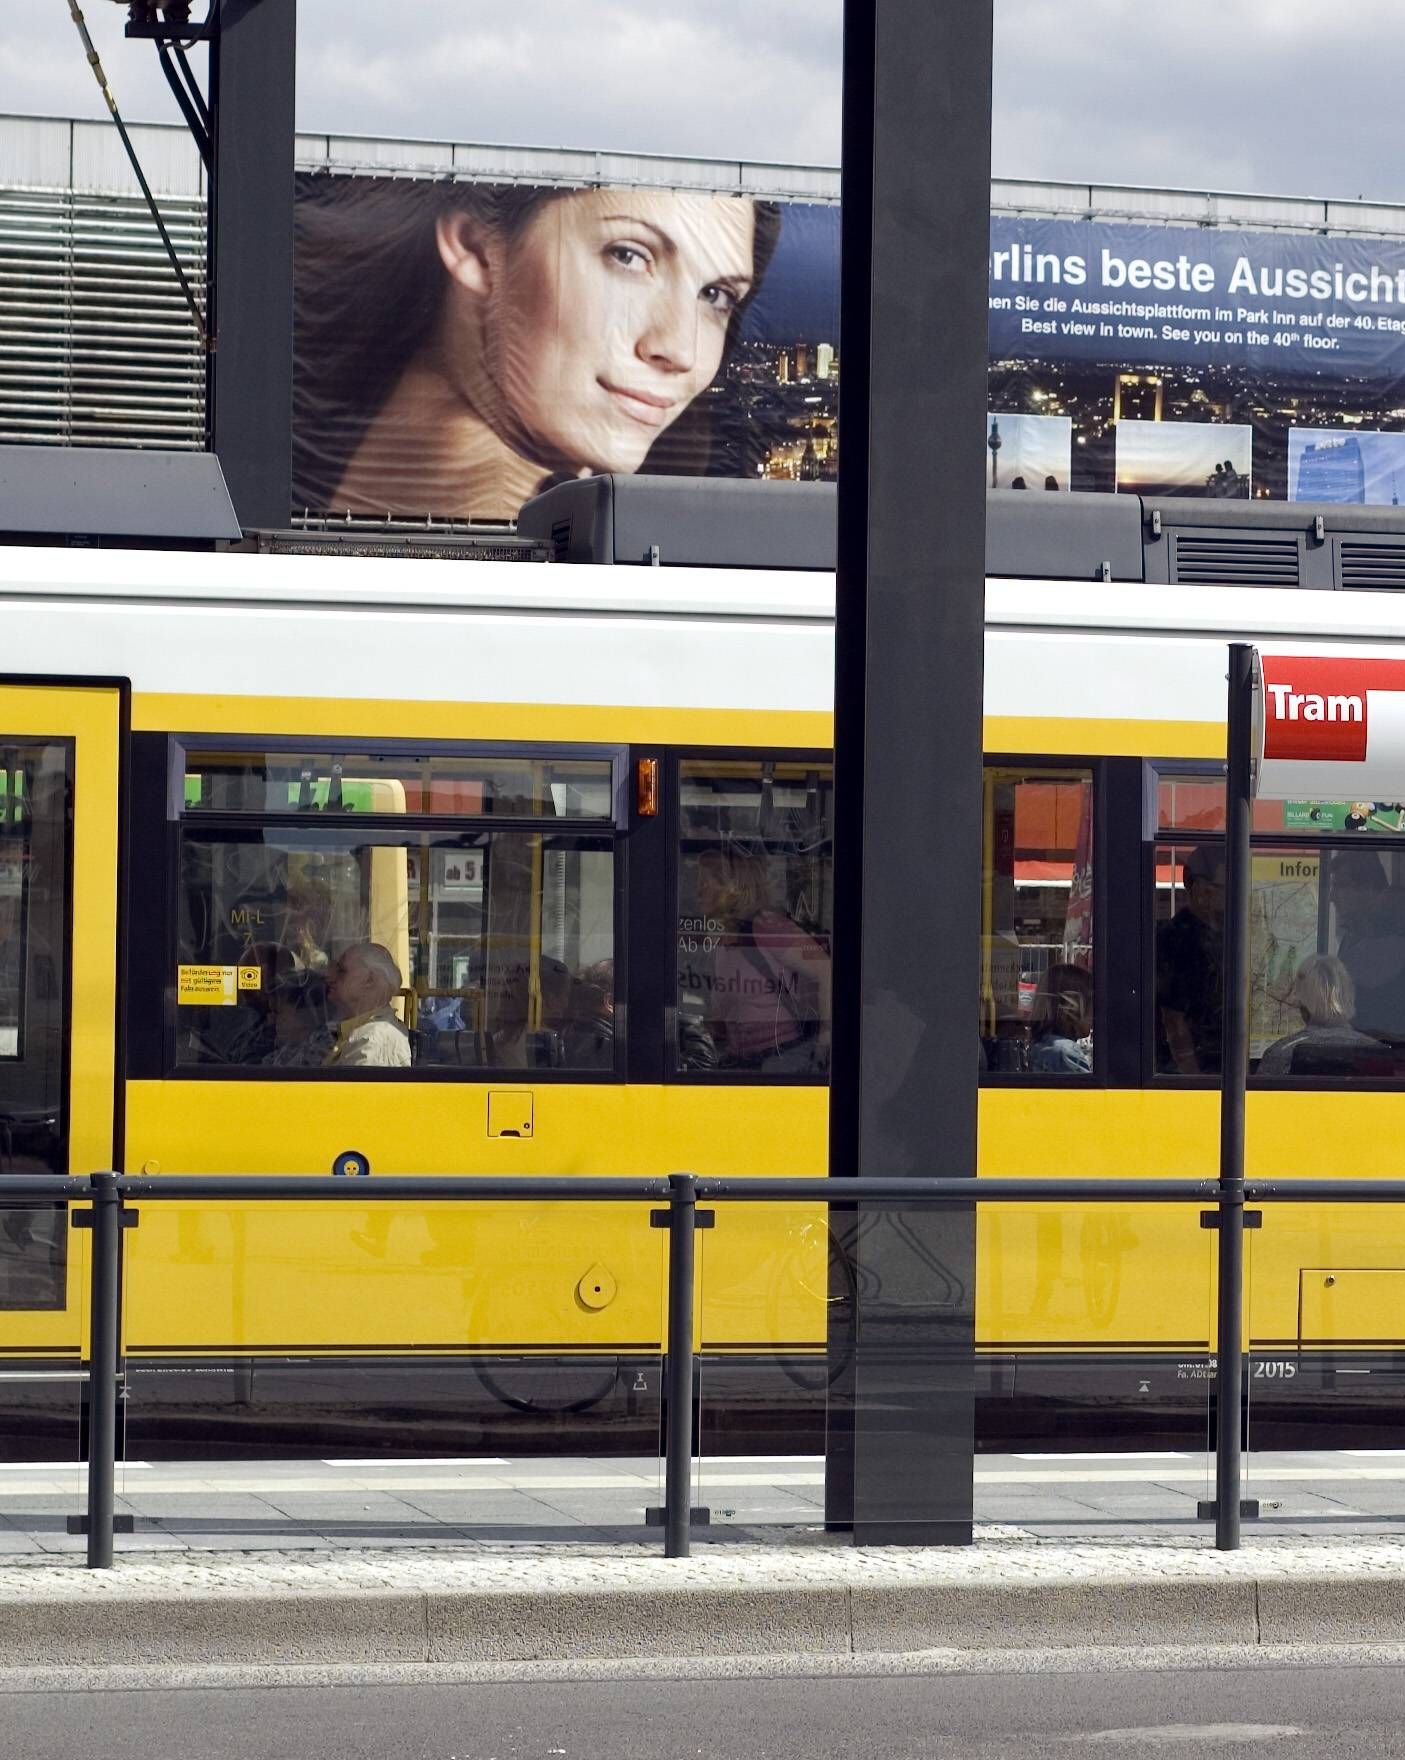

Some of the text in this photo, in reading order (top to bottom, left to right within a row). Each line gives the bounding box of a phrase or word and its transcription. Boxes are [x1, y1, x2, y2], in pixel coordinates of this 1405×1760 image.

[989, 244, 1087, 285] rlins
[1101, 249, 1215, 292] beste
[1015, 296, 1039, 311] Sie
[1043, 297, 1067, 312] die
[1071, 299, 1211, 321] Aussichtsplattform
[1215, 307, 1232, 321] im
[1237, 308, 1268, 324] Park
[1273, 310, 1295, 325] Inn
[1300, 312, 1322, 326] auf
[1327, 314, 1351, 328] der
[1354, 315, 1375, 329] 40.
[1022, 318, 1057, 334] Best
[1061, 320, 1095, 336] view
[1100, 322, 1113, 336] in
[1118, 324, 1158, 339] town.
[1162, 325, 1190, 341] See
[1194, 329, 1220, 344] you
[1224, 332, 1242, 344] on
[1247, 331, 1269, 345] the
[1303, 333, 1340, 349] floor.
[1267, 684, 1363, 722] Tram
[1254, 1362, 1296, 1378] 2015
